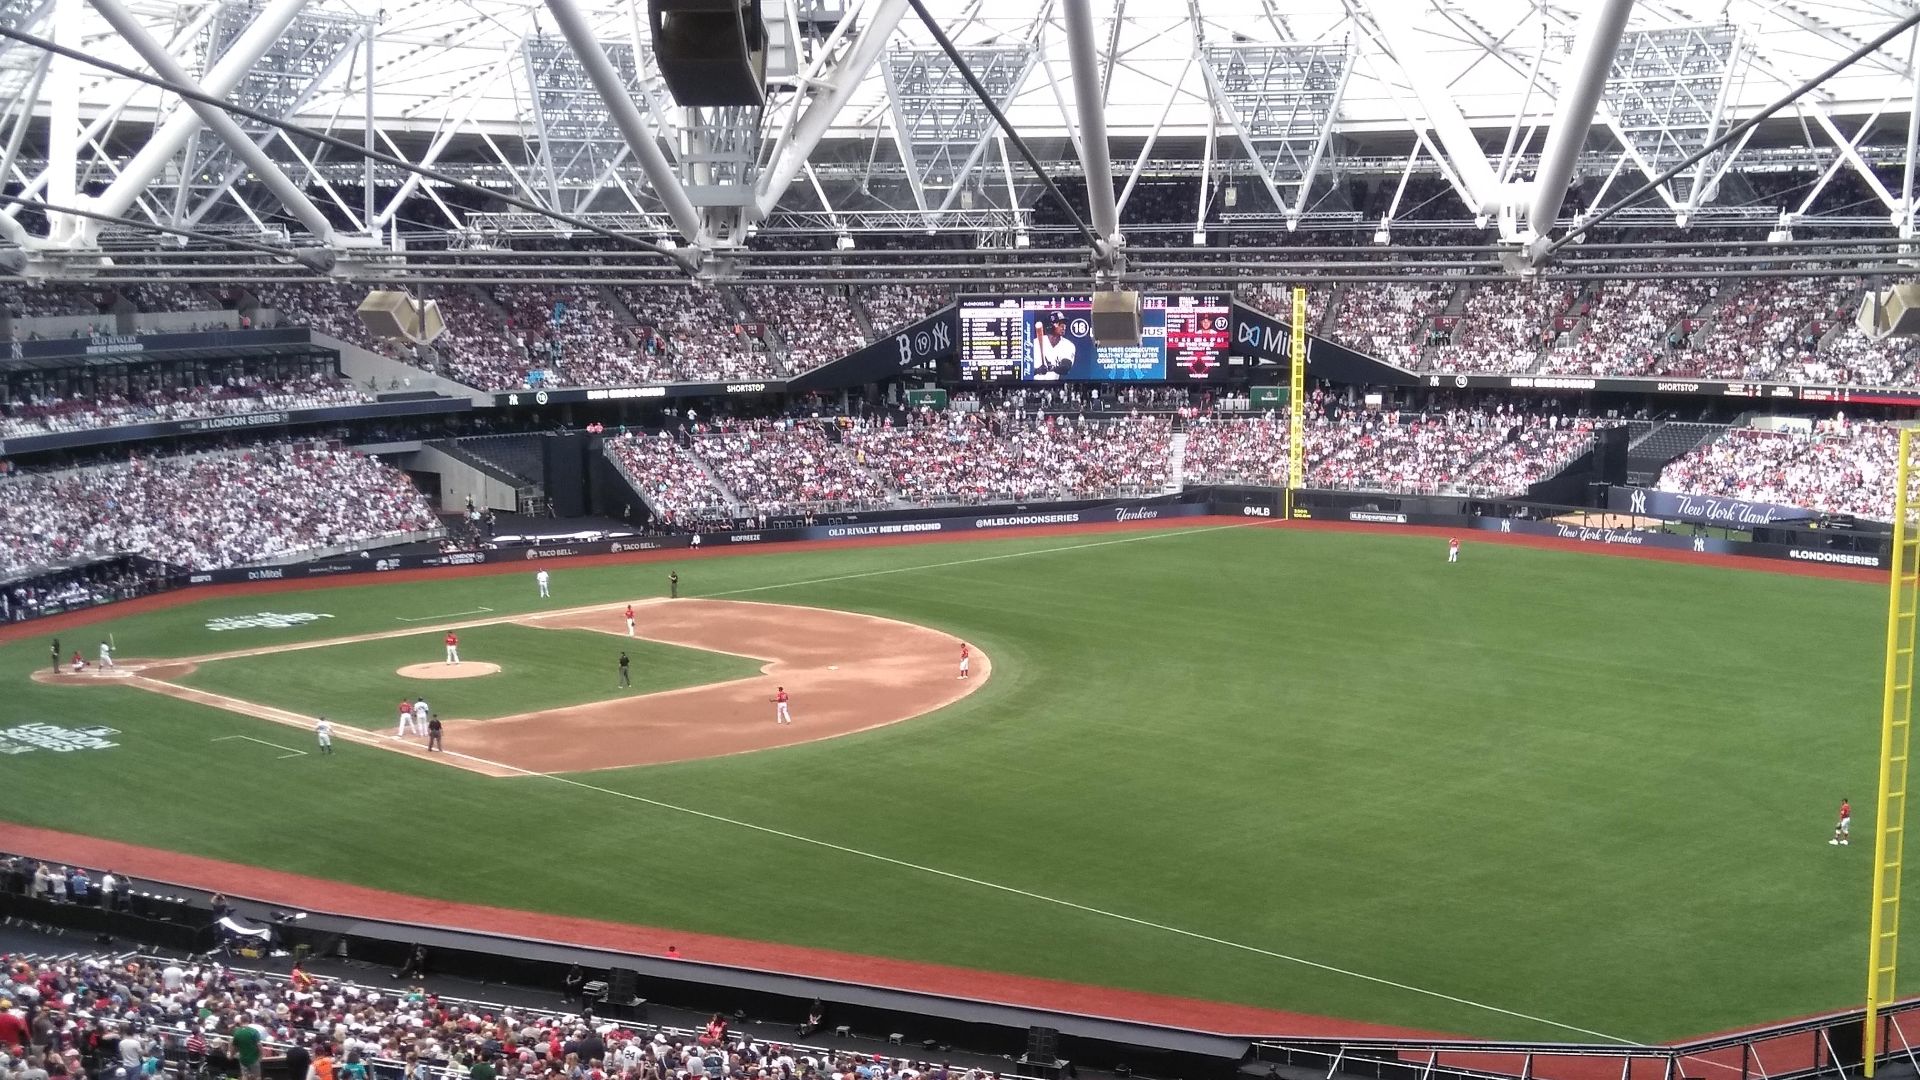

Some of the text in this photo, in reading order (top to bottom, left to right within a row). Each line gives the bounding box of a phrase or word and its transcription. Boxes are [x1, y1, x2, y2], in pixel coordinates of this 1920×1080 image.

[1073, 322, 1086, 334] 18
[896, 334, 912, 366] B
[1263, 326, 1312, 364] Mitl
[726, 384, 765, 393] SHORTSTOP
[1658, 383, 1699, 392] SHORTSTOP
[209, 416, 246, 429] LONDON
[247, 413, 280, 425] SERIES
[1244, 506, 1270, 516] @MLB
[1630, 490, 1647, 514] NY
[1676, 495, 1705, 517] New
[1706, 500, 1736, 520] York
[1115, 506, 1158, 522] Yankees
[975, 514, 1079, 528] @MLBLONDONSERIES
[1501, 519, 1511, 533] NY
[828, 523, 941, 536] OLD RIVALRY NEW GROUND
[1556, 524, 1643, 544] New York Yankees
[731, 534, 761, 542] BIOFREEZE
[1693, 538, 1704, 551] NY
[1790, 550, 1879, 566] #LONDONSERIES
[260, 569, 283, 578] Mitel
[624, 1051, 636, 1059] 24
